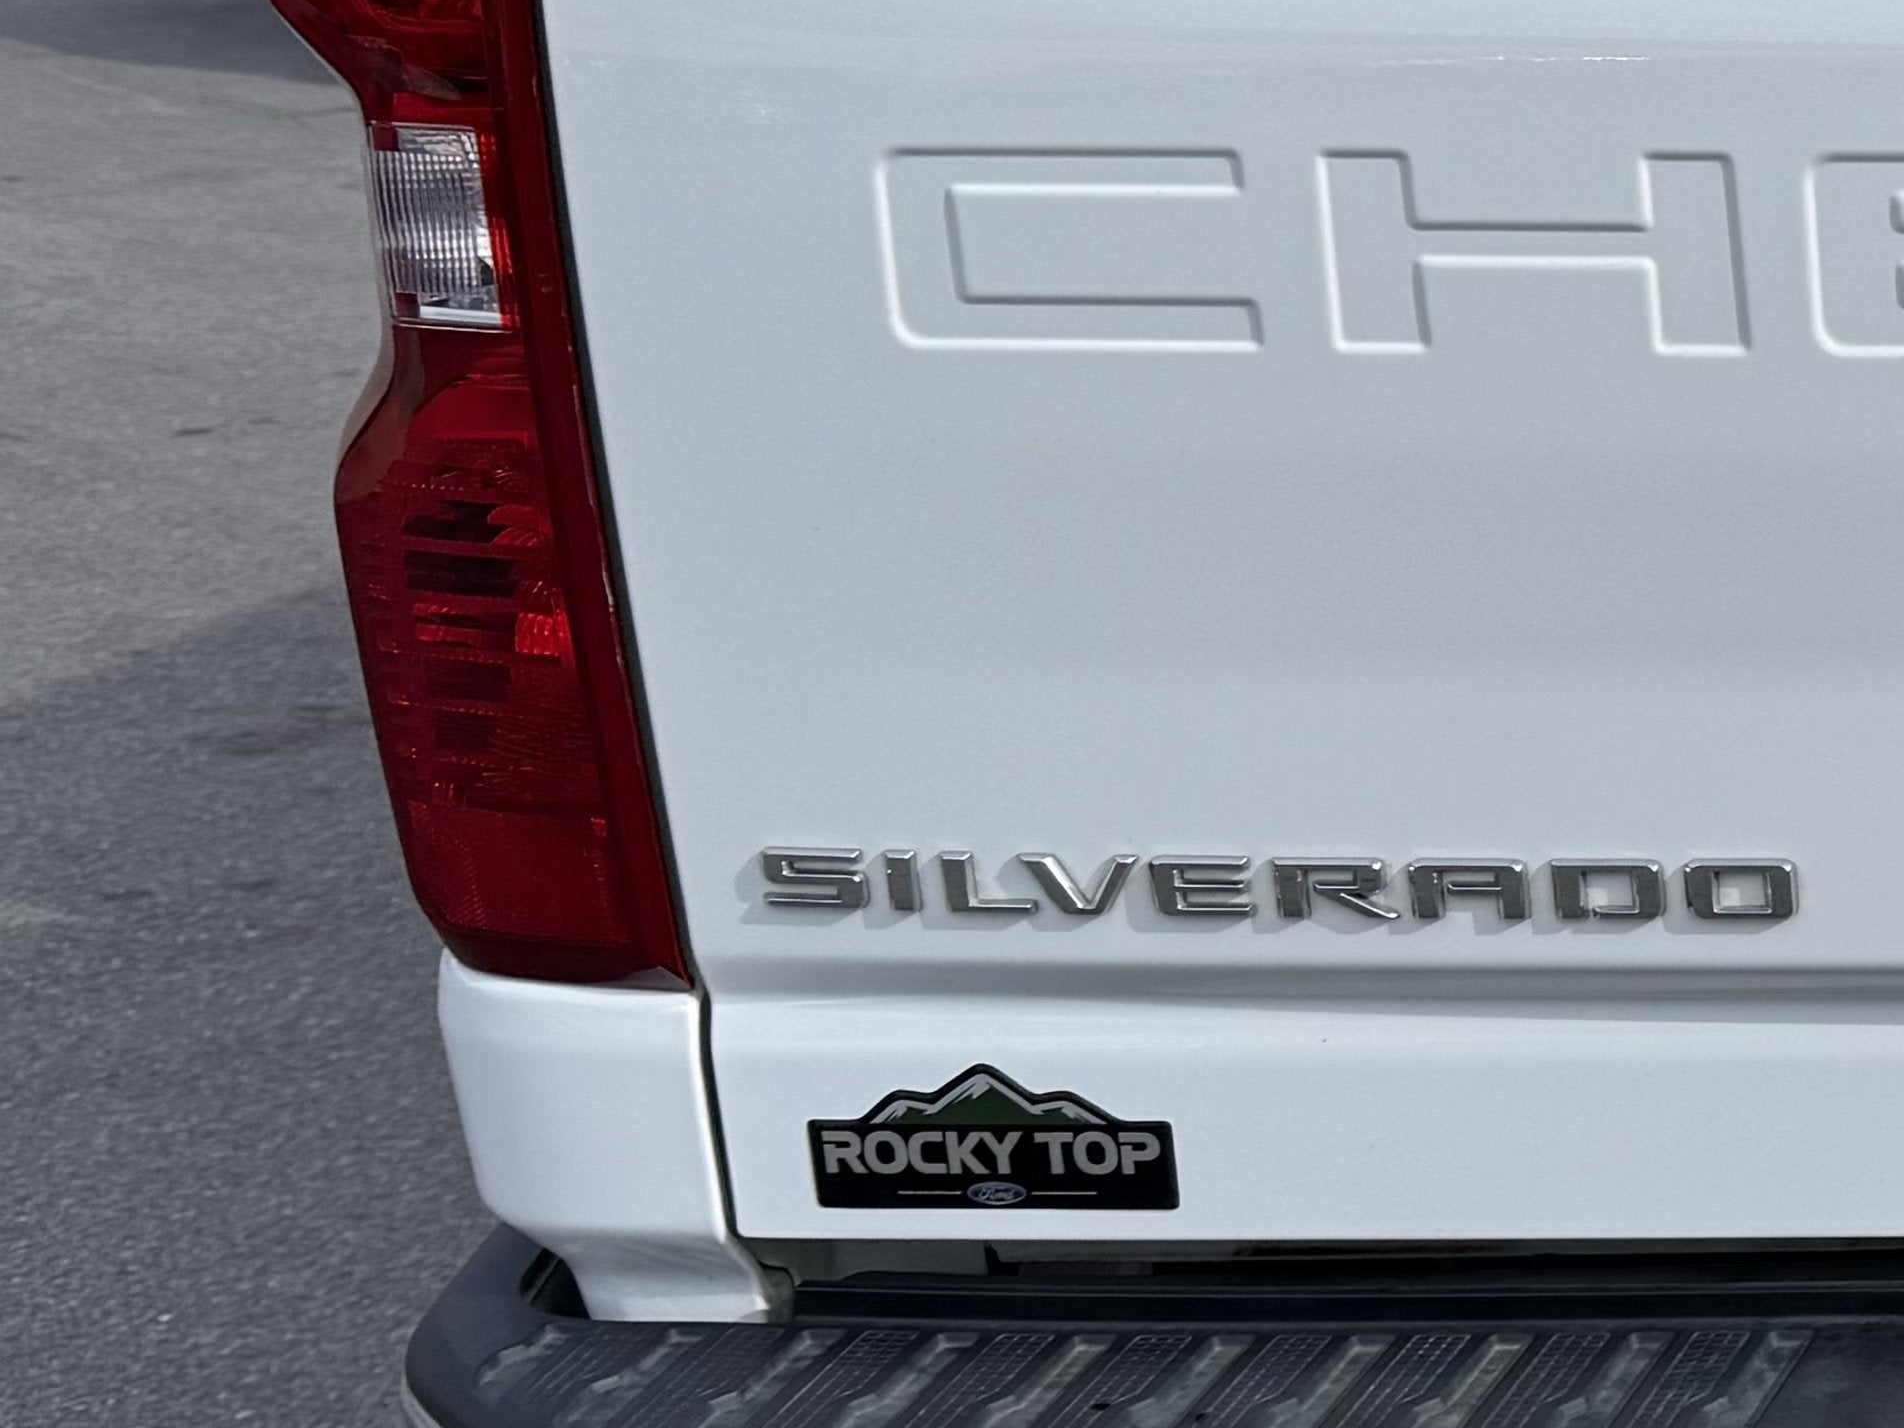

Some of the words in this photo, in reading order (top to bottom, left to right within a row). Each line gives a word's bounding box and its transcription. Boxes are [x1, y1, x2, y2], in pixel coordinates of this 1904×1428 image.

[761, 846, 1798, 920] SILVERADO
[821, 1130, 1023, 1175] ROCKY
[1034, 1130, 1161, 1175] TOP
